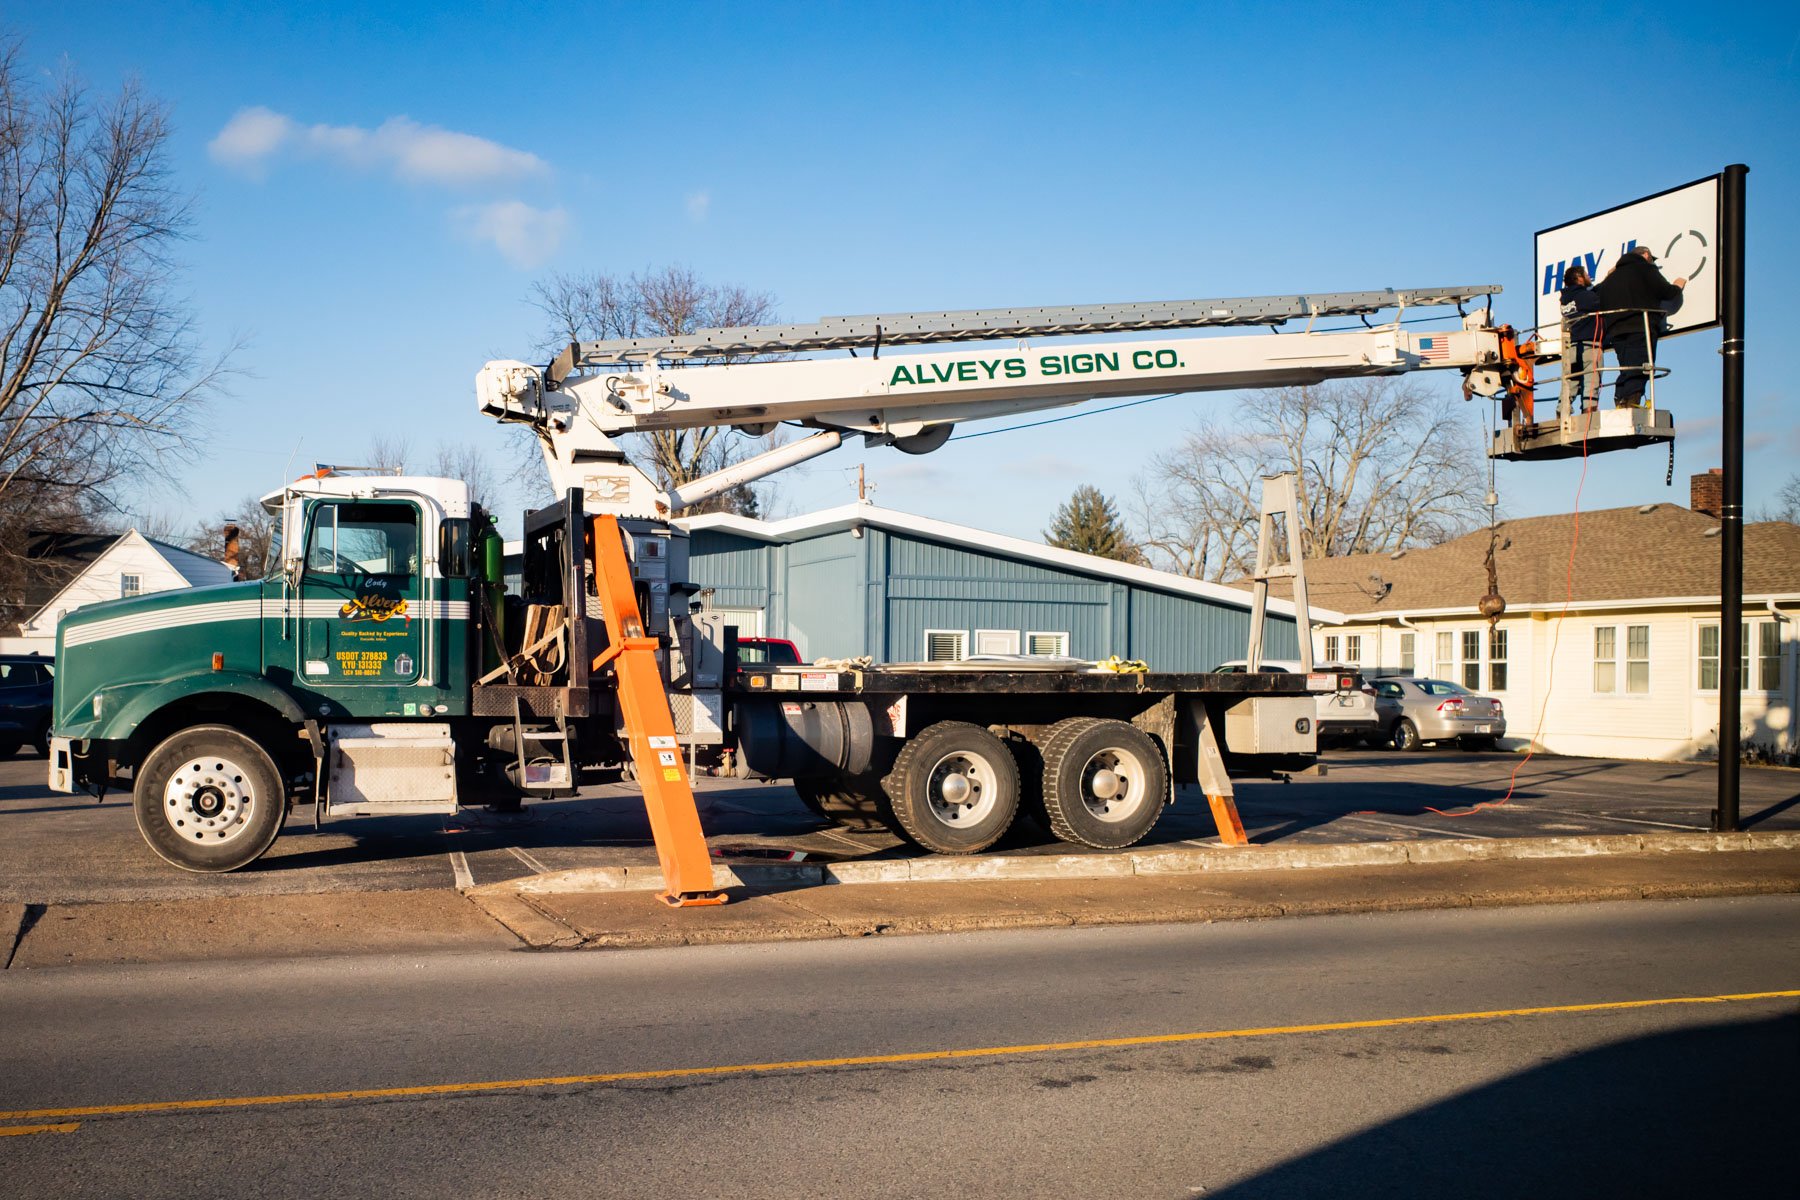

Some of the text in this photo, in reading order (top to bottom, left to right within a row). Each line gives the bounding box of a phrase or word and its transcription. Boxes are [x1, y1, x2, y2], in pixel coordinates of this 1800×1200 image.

[889, 349, 1185, 386] ALVEYS SIGN CO.
[365, 578, 387, 588] Cody
[336, 652, 388, 660] USDOT 378833
[342, 661, 382, 669] KYU 131333
